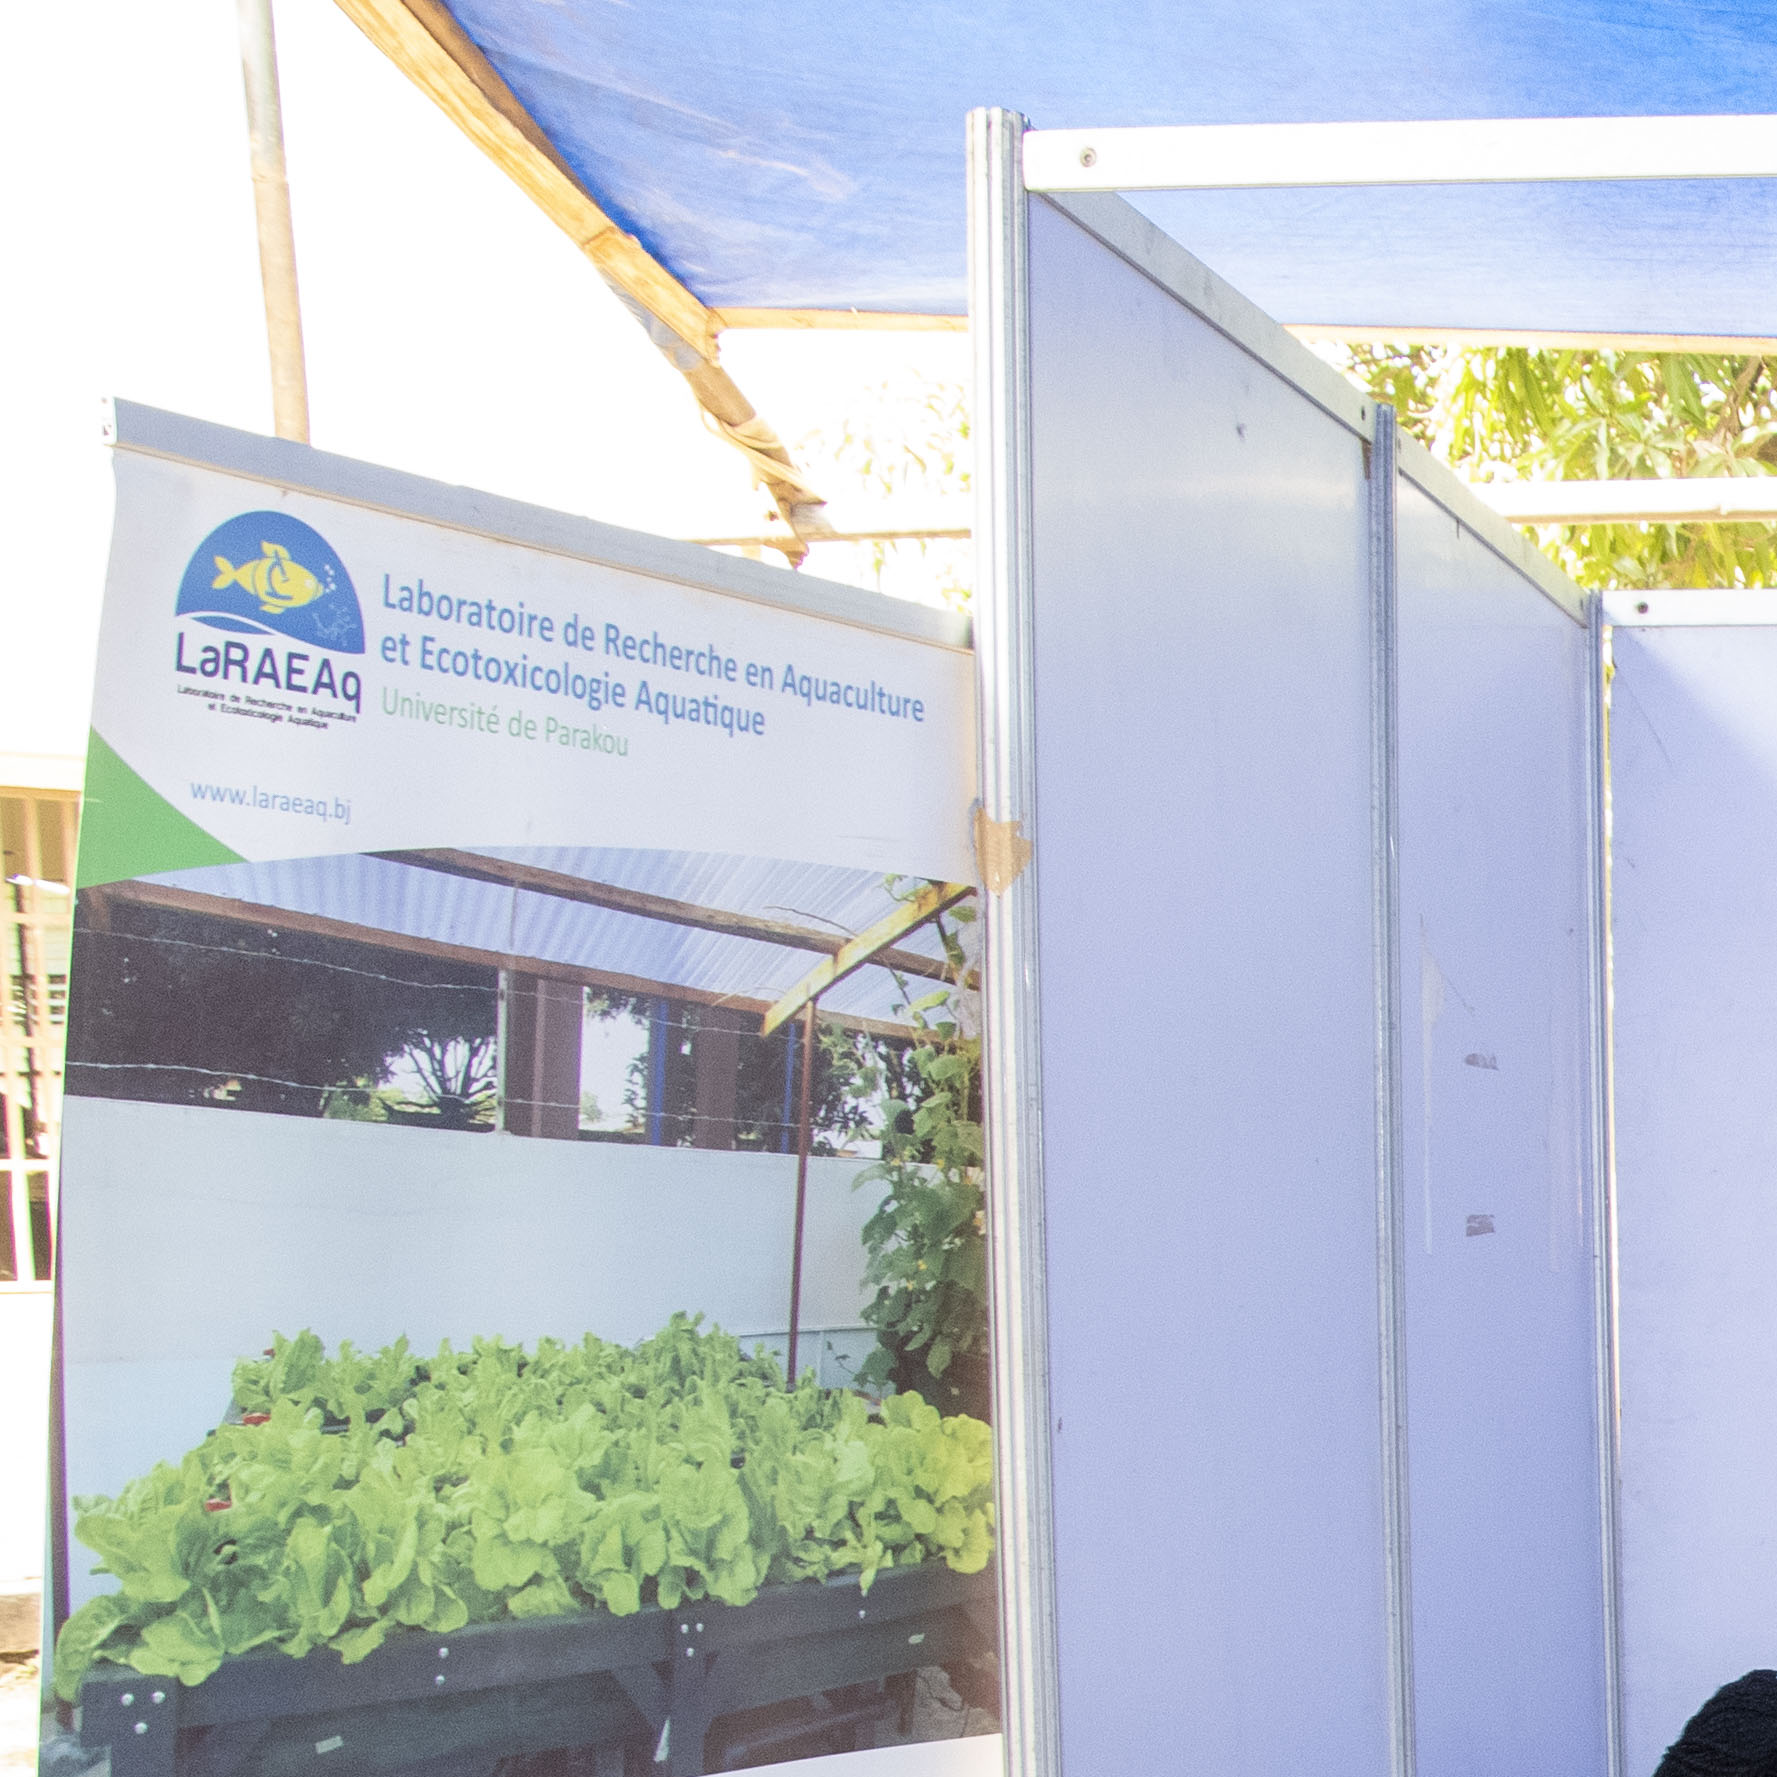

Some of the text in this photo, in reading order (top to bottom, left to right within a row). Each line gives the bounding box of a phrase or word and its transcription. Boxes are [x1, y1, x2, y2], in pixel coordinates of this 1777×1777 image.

[176, 632, 361, 714] LaRAEAq
[381, 634, 766, 739] et Ecotoxicologie Aquatique
[383, 572, 926, 724] Laboratoire de Recherche en Aquaculture
[382, 686, 629, 758] Université de Parakou
[190, 781, 352, 826] www.laraeaq.bj
